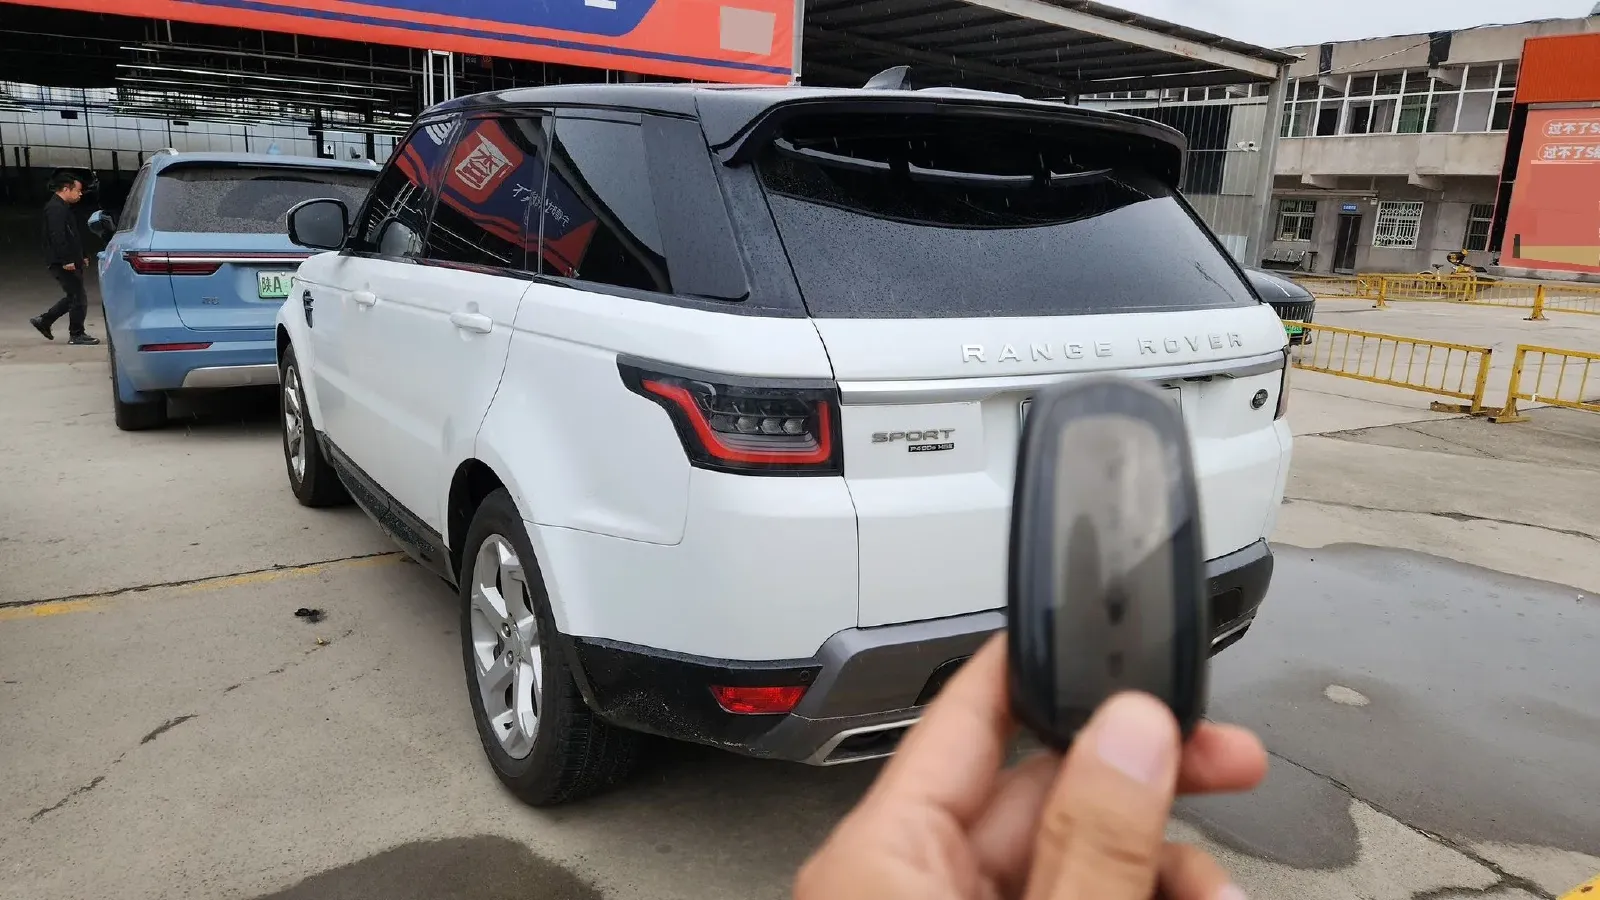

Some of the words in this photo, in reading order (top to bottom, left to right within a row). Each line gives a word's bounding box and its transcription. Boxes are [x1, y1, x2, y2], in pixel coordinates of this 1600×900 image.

[261, 276, 296, 293] 陕A
[961, 339, 1113, 362] RANGE
[1138, 332, 1243, 355] ROVER
[871, 428, 956, 443] SPORT
